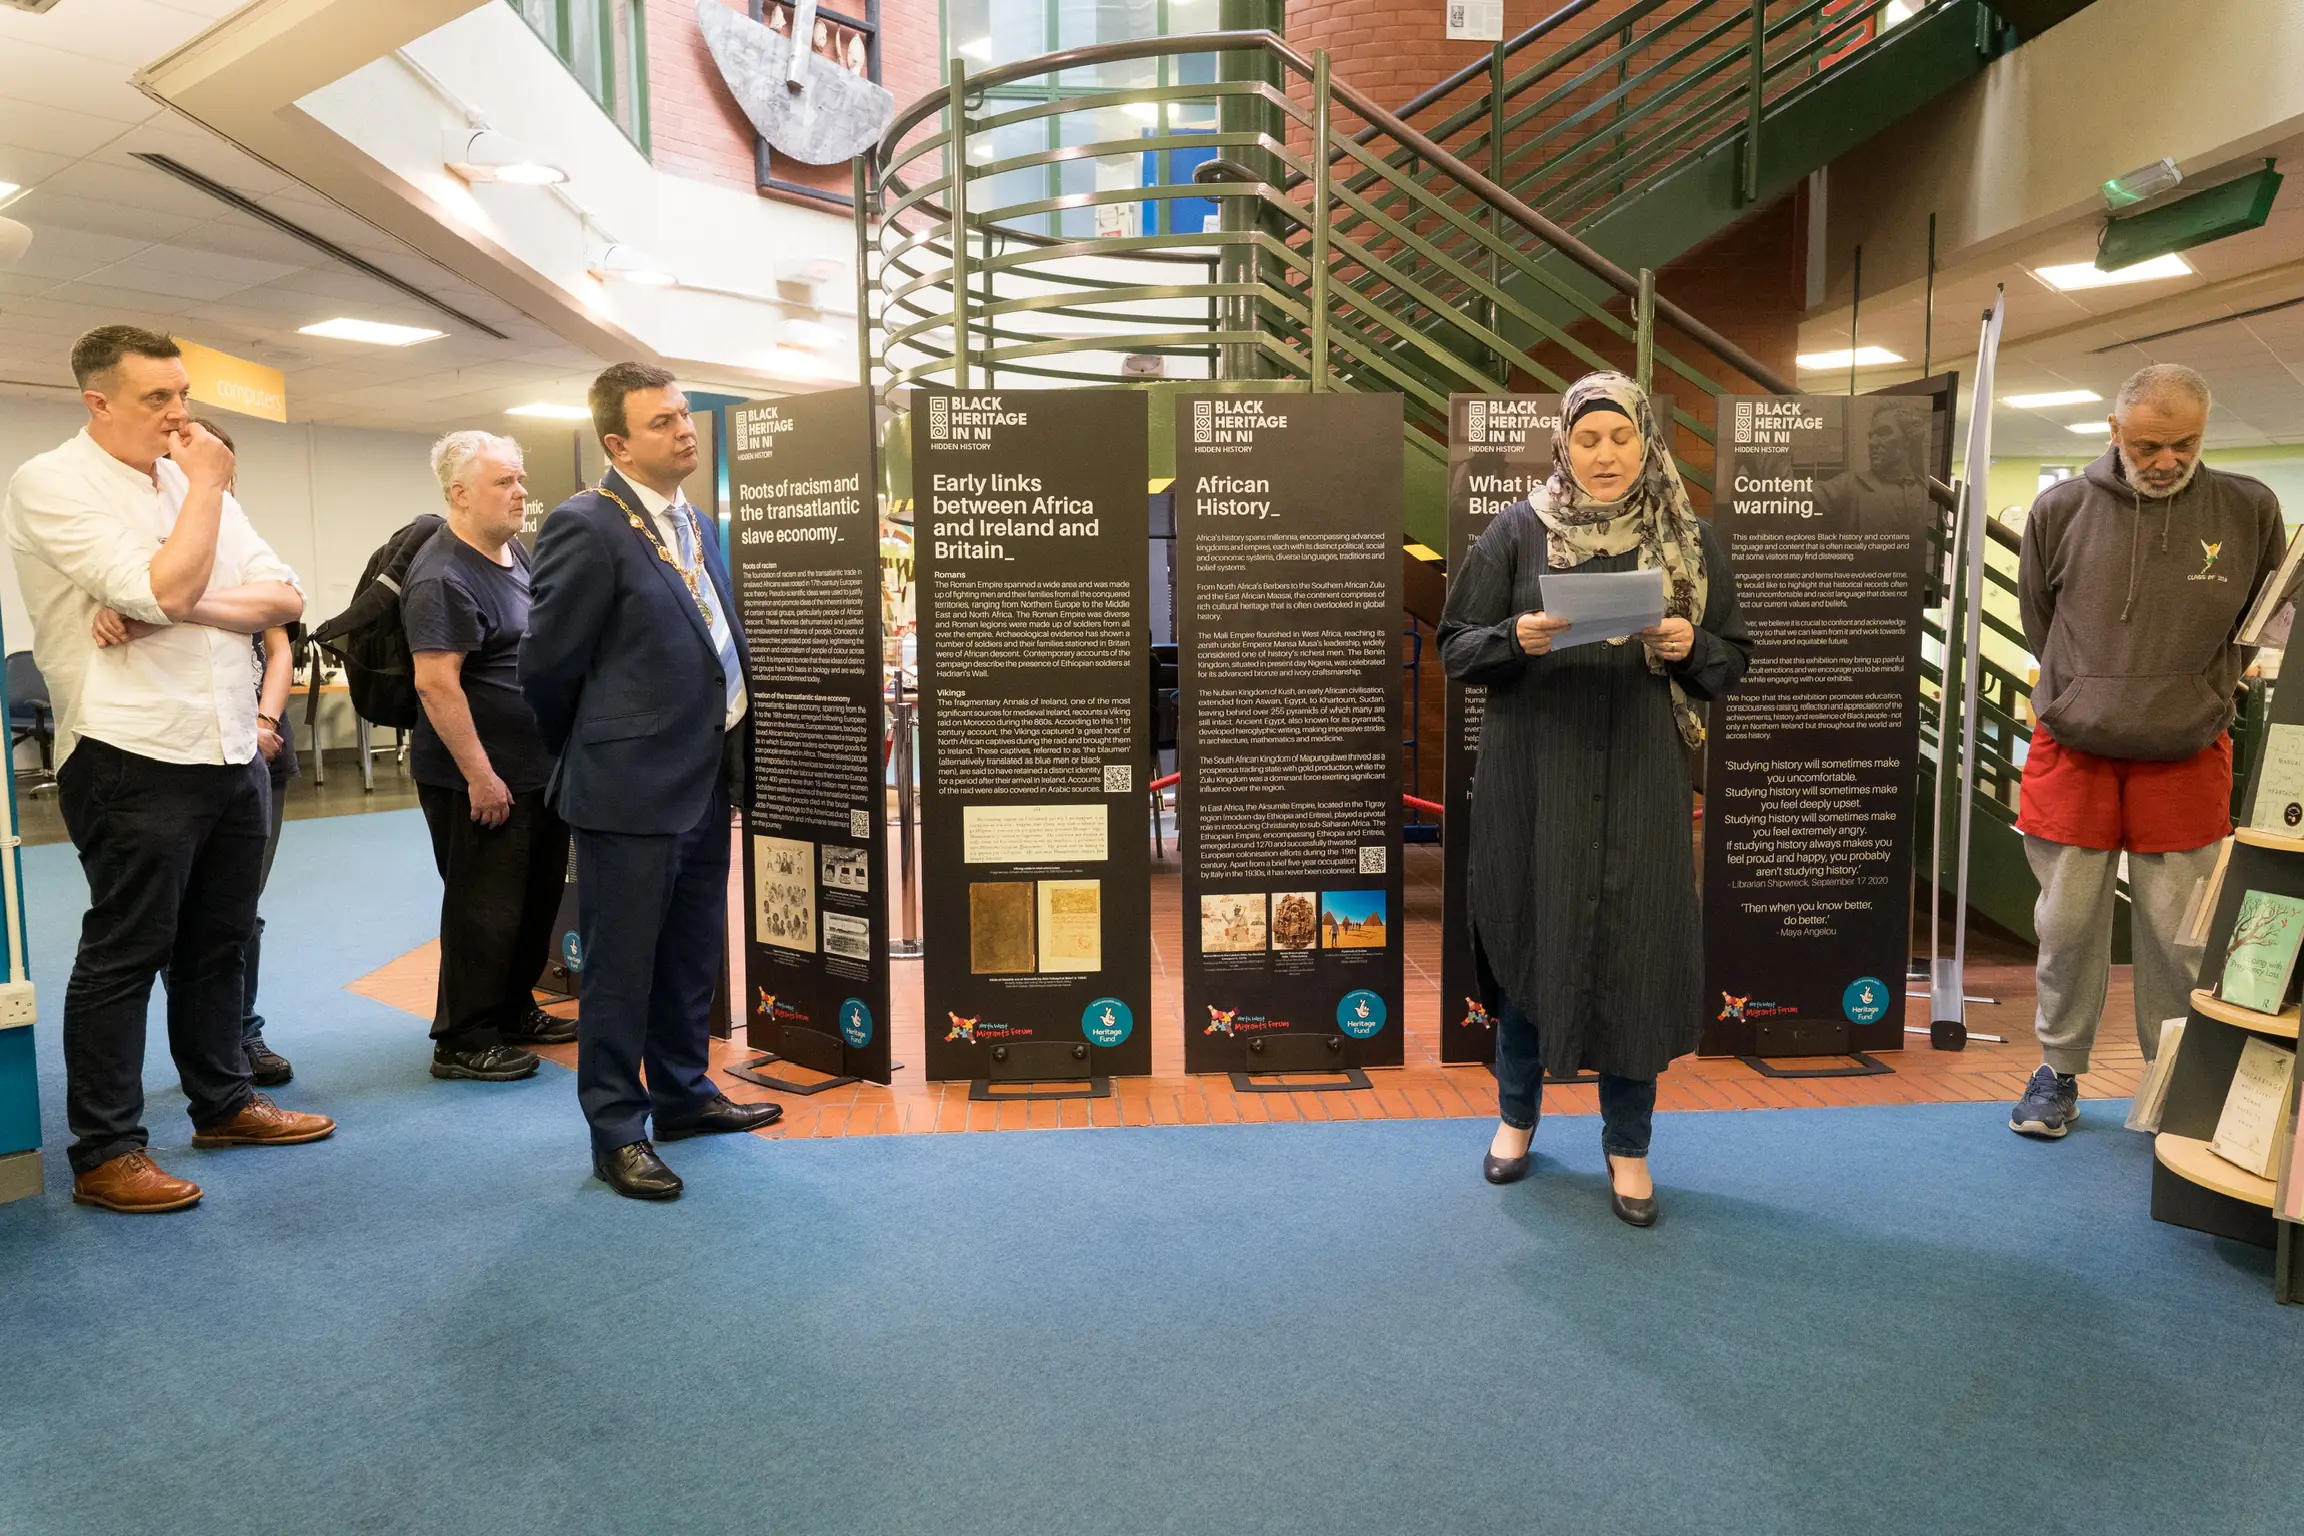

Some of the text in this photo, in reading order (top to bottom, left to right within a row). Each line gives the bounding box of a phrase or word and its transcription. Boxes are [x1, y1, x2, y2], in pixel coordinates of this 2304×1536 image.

[217, 380, 282, 411] computers
[952, 396, 1002, 410] BLACK
[1215, 401, 1264, 414] BLACK
[1489, 401, 1536, 414] BLACK
[1756, 403, 1800, 415] BLACK
[748, 407, 778, 421] BLACK
[952, 413, 1027, 425] HERITAGE
[749, 419, 793, 435] HERITAGE
[1215, 416, 1287, 428] HERITAGE
[1489, 416, 1561, 428] HERITAGE
[1755, 418, 1822, 429] HERITAGE
[953, 427, 991, 439] IN NI
[1216, 430, 1252, 442] IN NI
[1489, 431, 1525, 442] IN NI
[1755, 431, 1789, 442] IN NI
[750, 436, 772, 448] IN NI
[738, 451, 772, 460] HIDDEN HISTORY
[740, 473, 859, 500] Roots of racism and
[933, 474, 1042, 495] Early links
[1196, 476, 1269, 493] African
[1469, 475, 1522, 492] What
[1734, 476, 1813, 492] Content
[740, 496, 859, 521] the transatlantic
[933, 496, 1093, 514] between Africa
[933, 519, 1099, 536] and Ireland and
[741, 528, 774, 544] slave
[1221, 533, 1244, 543] history
[1245, 535, 1265, 543] spans
[1299, 532, 1349, 542] encompassing
[1350, 532, 1384, 540] advanced
[1785, 533, 1815, 542] explores
[1838, 533, 1862, 542] history
[936, 689, 965, 697] Vikings
[1771, 758, 1802, 771] history
[1804, 758, 1819, 768] will
[1821, 757, 1872, 768] sometimes
[1874, 757, 1899, 768] make
[2279, 757, 2300, 766] MANUAL
[1766, 774, 1784, 785] you
[1725, 783, 1897, 799] Studying history will sometimes make
[1760, 801, 1778, 812] you
[1780, 799, 1797, 809] feel
[1799, 798, 1831, 811] deeply
[1724, 810, 1896, 826] Studying history will sometimes make
[1752, 828, 1770, 839] you
[1772, 825, 1789, 836] feel
[1791, 824, 1836, 838] extremely
[1726, 837, 1892, 852] If studying history always makes you
[1727, 852, 1744, 862] feel
[1746, 852, 1774, 865] proud
[1776, 851, 1794, 862] and
[1829, 853, 1847, 863] you
[1849, 850, 1890, 863] probably
[1783, 864, 1824, 877] studying
[1732, 879, 1766, 888] Librarian
[1812, 877, 1854, 887] September
[1857, 877, 1866, 885] 17
[1867, 876, 1888, 885] 2020
[1768, 900, 1795, 911] when
[1797, 902, 1814, 913] you
[1816, 899, 1842, 910] know
[1783, 914, 1796, 924] do
[1780, 926, 1836, 938] Maya Angelou
[2266, 970, 2279, 978] Loss
[1852, 1007, 1879, 1015] Heritage
[1235, 1020, 1290, 1032] Migrants Forum
[1347, 1020, 1376, 1028] Heritage
[846, 1028, 865, 1038] Heritage
[976, 1028, 1032, 1038] Migrants Forum
